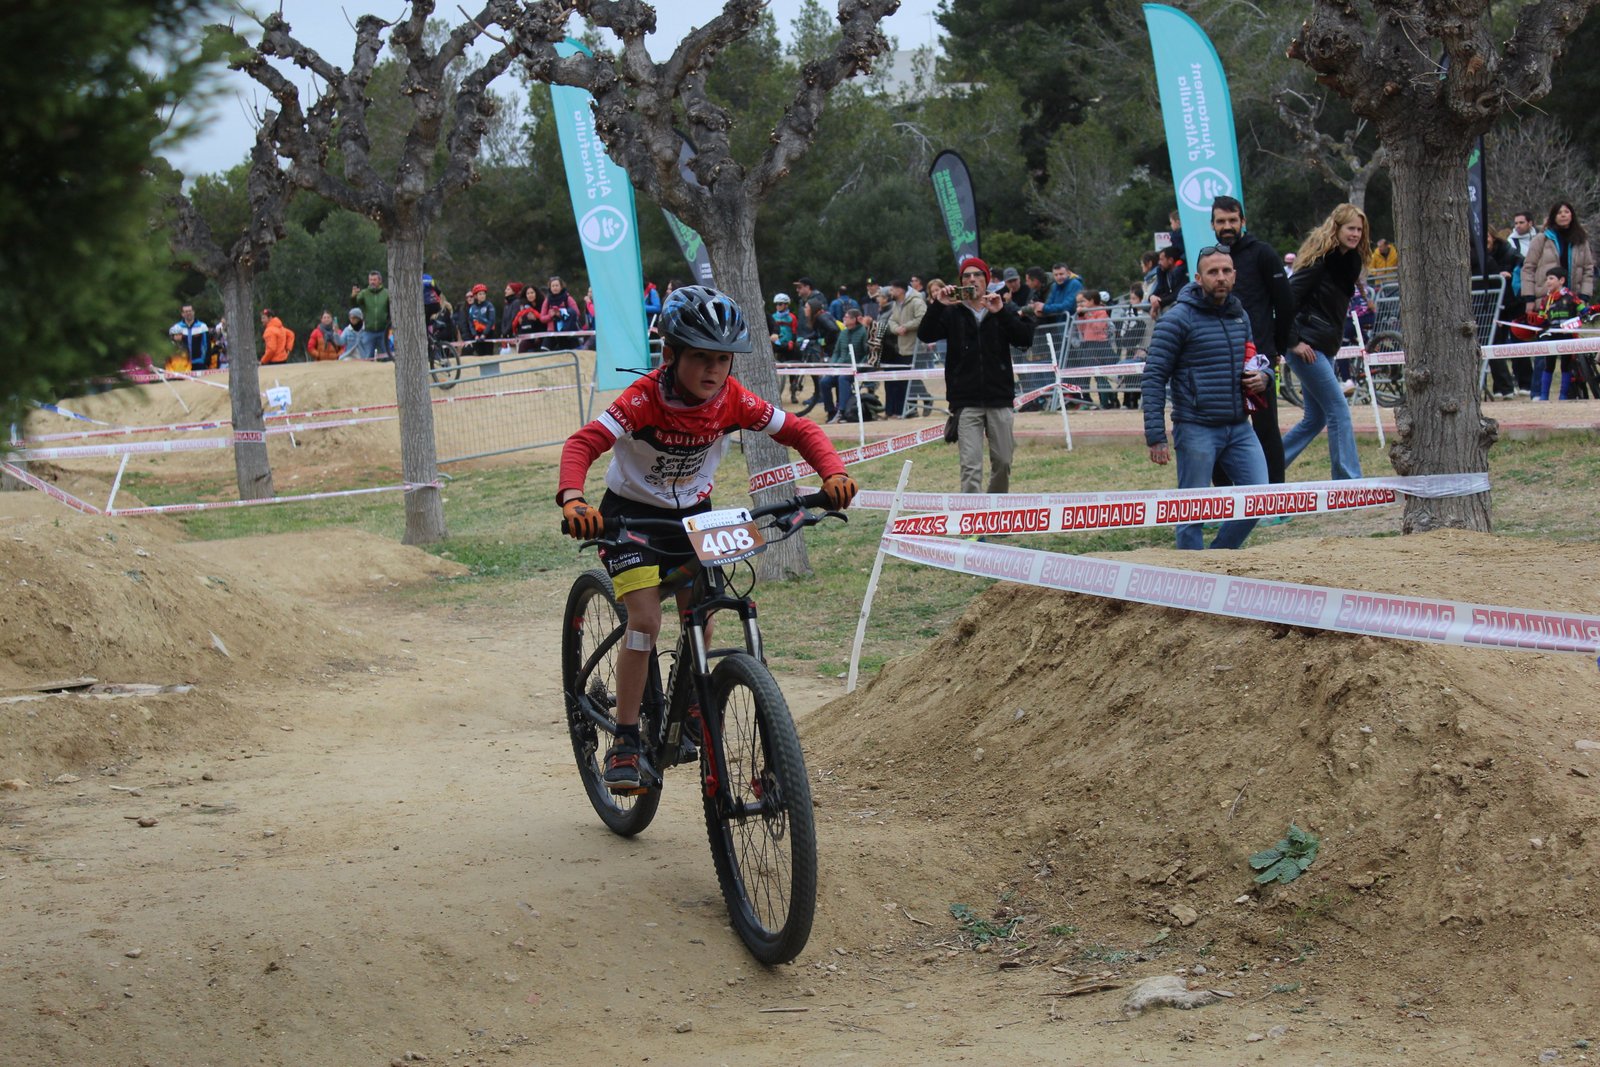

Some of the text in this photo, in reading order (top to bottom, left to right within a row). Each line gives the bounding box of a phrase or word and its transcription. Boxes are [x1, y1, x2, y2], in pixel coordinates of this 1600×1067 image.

[656, 430, 724, 446] BAUHAUS
[960, 508, 1049, 533] BAUHAUS
[1062, 502, 1146, 528] BAUHAUS
[1157, 498, 1235, 522] BAUHAUS
[1245, 492, 1318, 516] BAUHAUS
[1328, 489, 1396, 509] BAUHAUS
[702, 527, 755, 556] 408
